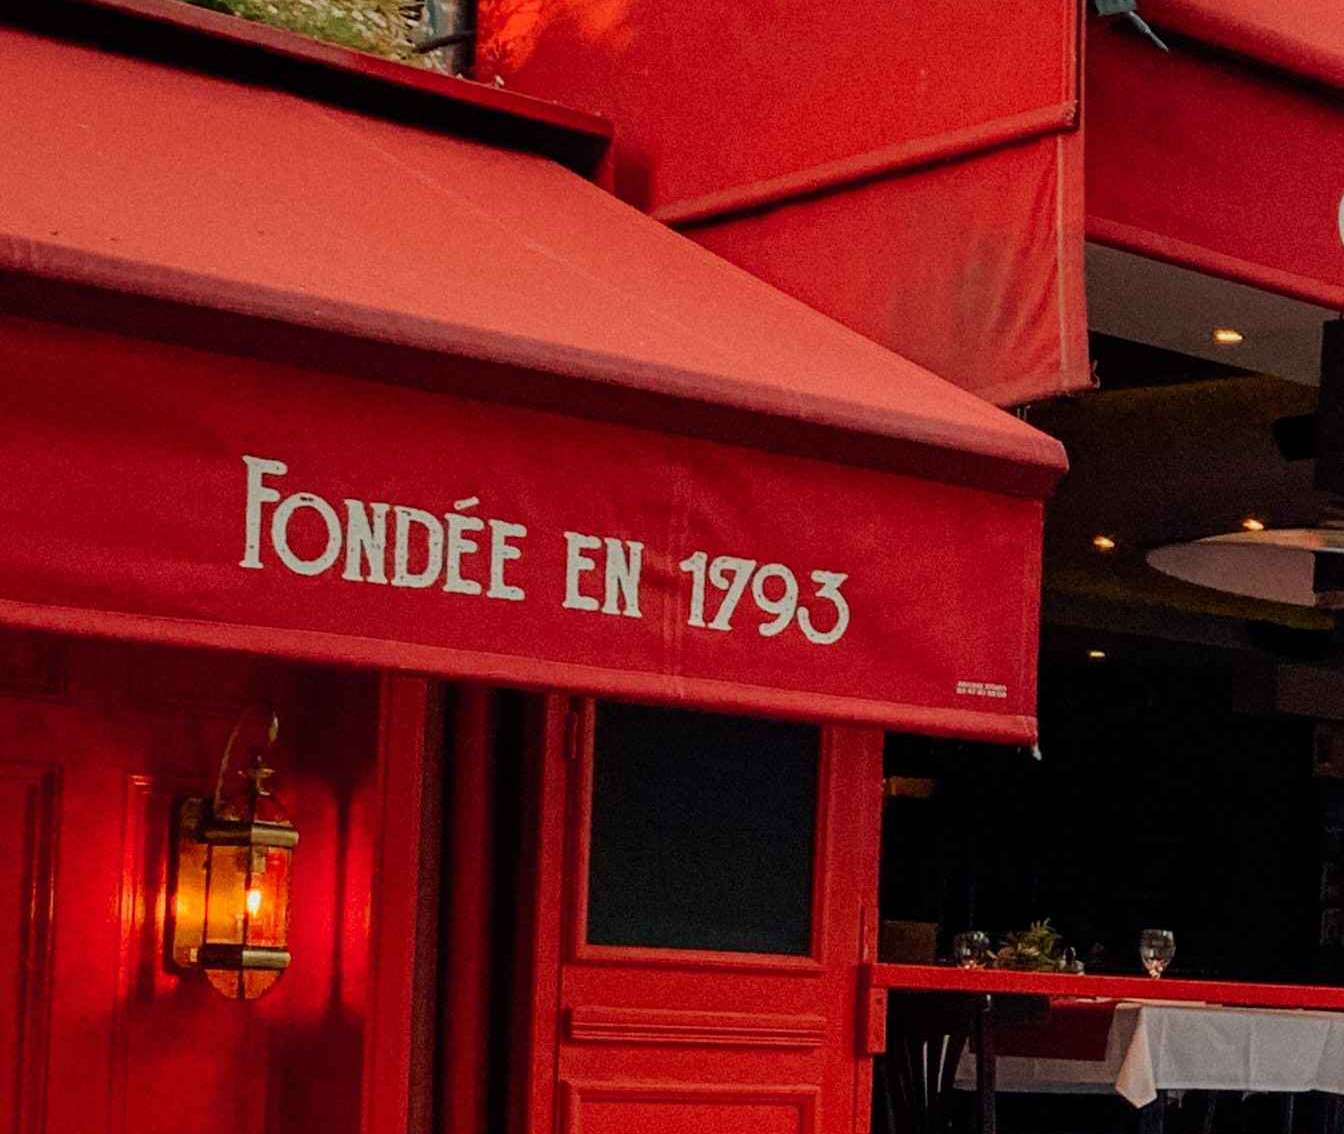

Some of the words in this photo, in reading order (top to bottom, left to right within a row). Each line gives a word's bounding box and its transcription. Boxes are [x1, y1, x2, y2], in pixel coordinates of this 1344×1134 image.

[240, 456, 528, 601] FONDÉE
[563, 530, 643, 618] EN
[680, 551, 850, 646] 1793
